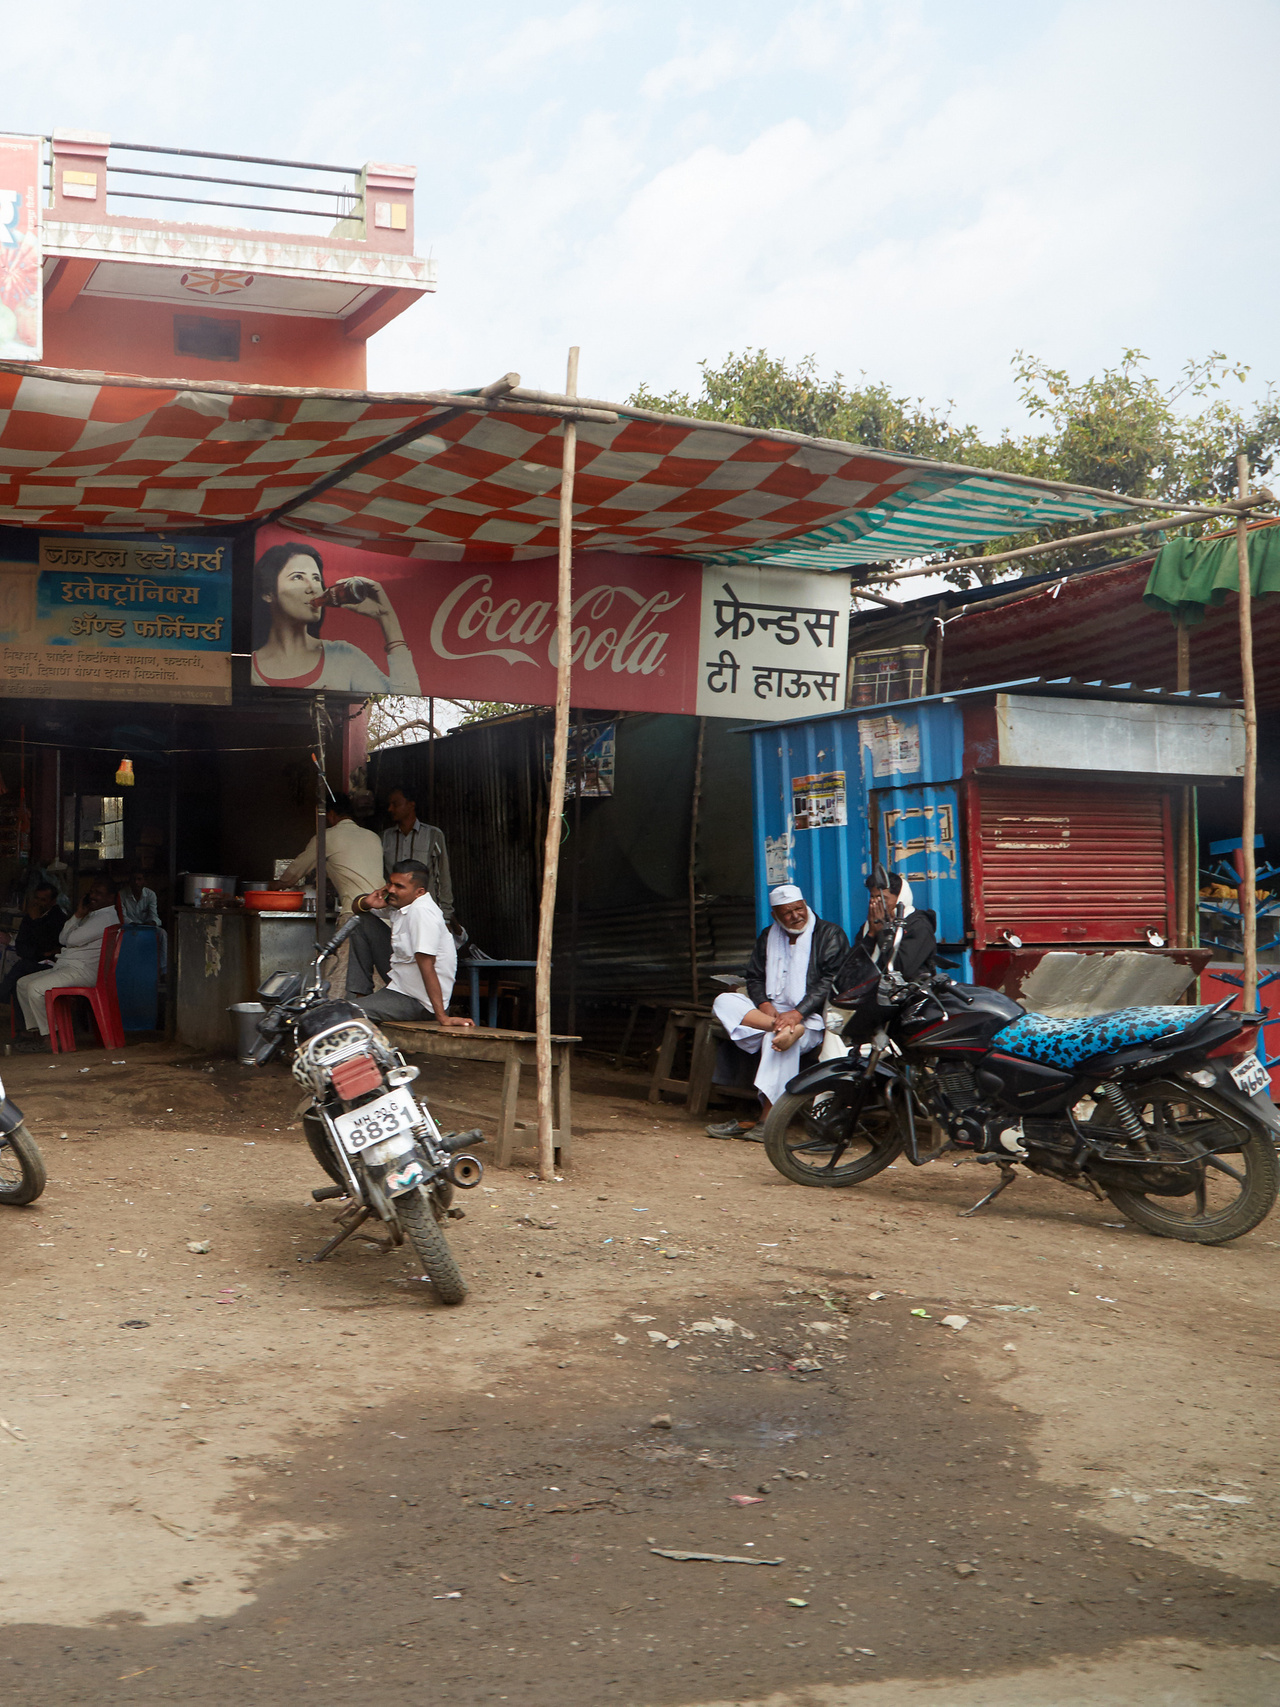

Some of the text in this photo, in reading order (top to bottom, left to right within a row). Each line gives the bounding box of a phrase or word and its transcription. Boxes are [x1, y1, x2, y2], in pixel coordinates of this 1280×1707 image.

[43, 544, 129, 568] जनरल
[60, 576, 201, 606] इलेक्ट्रॉनिक्स
[706, 648, 841, 703] टी हाऊस
[349, 1105, 414, 1148] 8831
